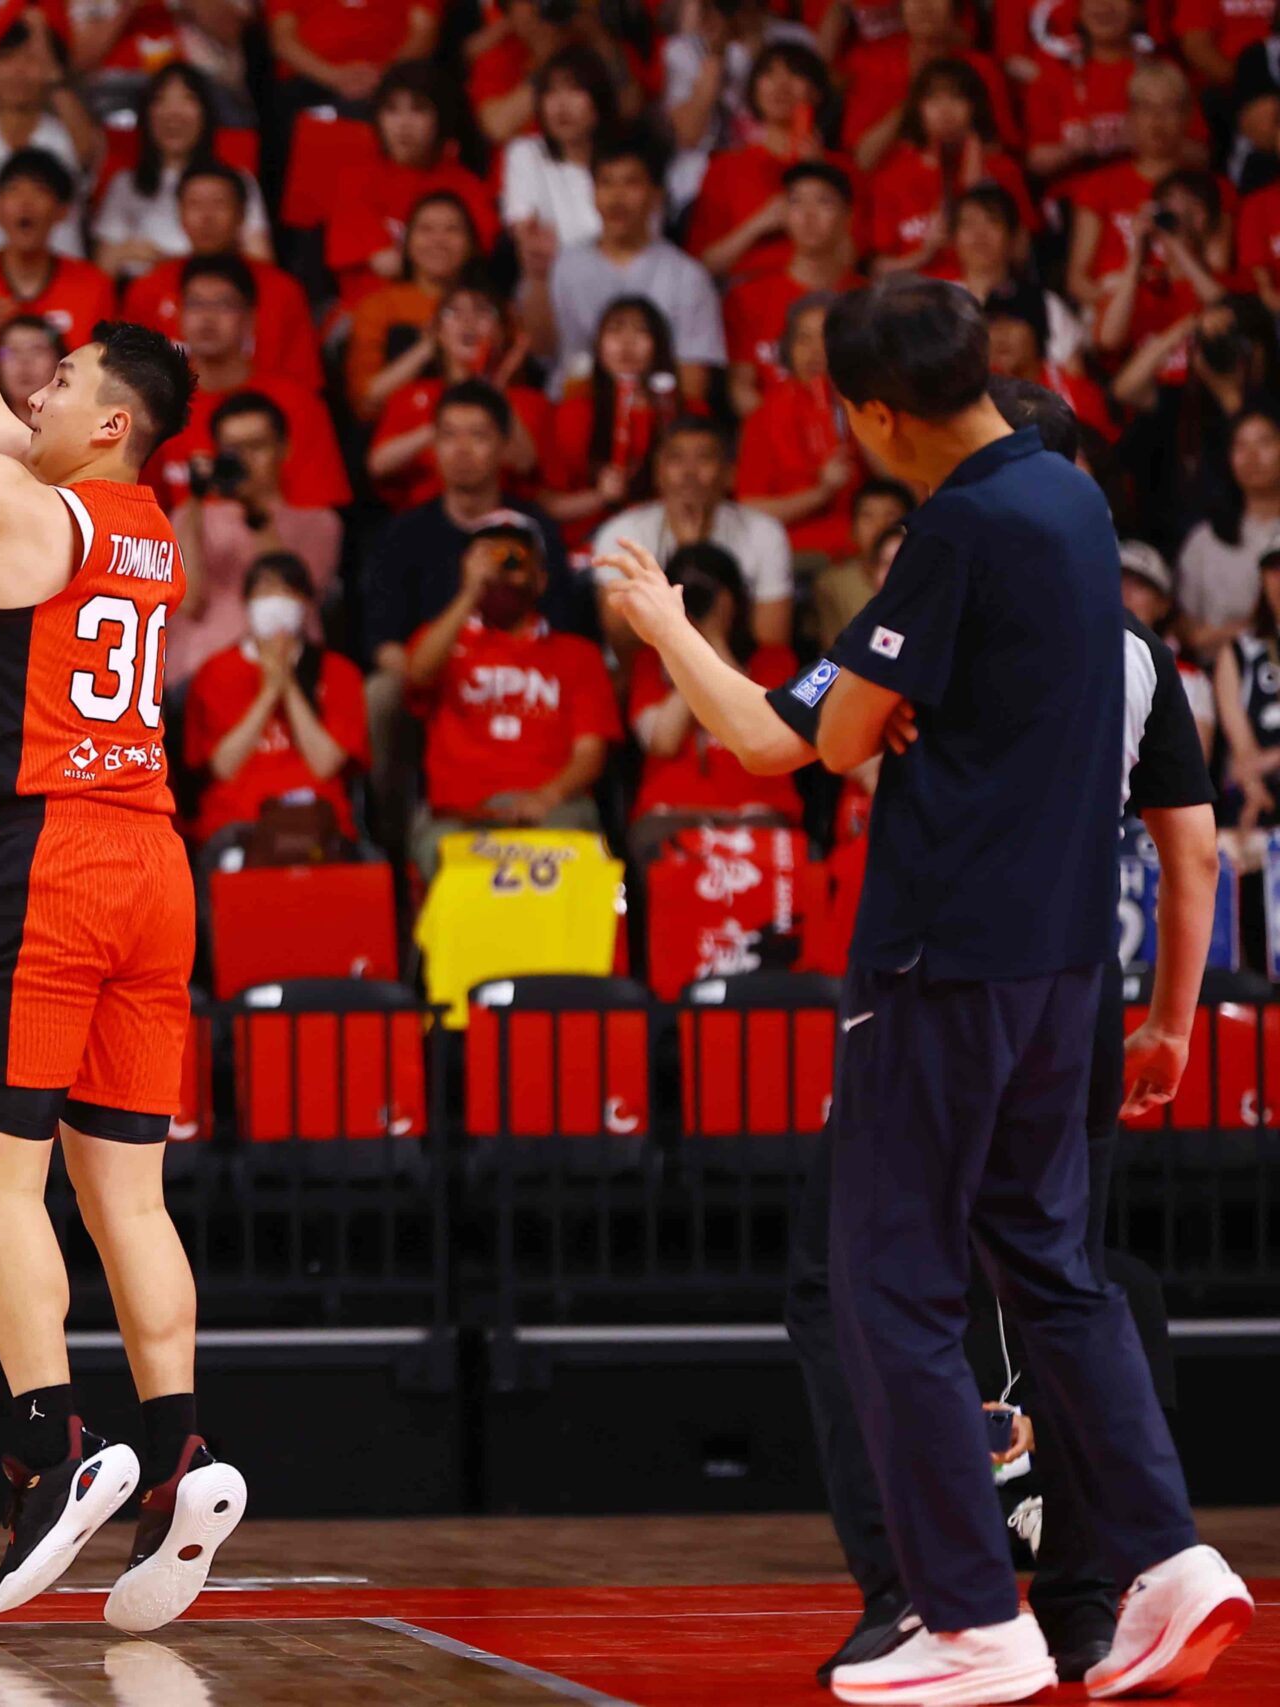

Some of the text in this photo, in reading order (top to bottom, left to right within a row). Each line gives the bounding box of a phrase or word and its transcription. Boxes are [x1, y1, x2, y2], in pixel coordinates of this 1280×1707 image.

[107, 533, 174, 583] TOMINAGA
[70, 594, 168, 730] 30
[462, 665, 561, 709] JPN
[64, 769, 96, 780] NISSAY
